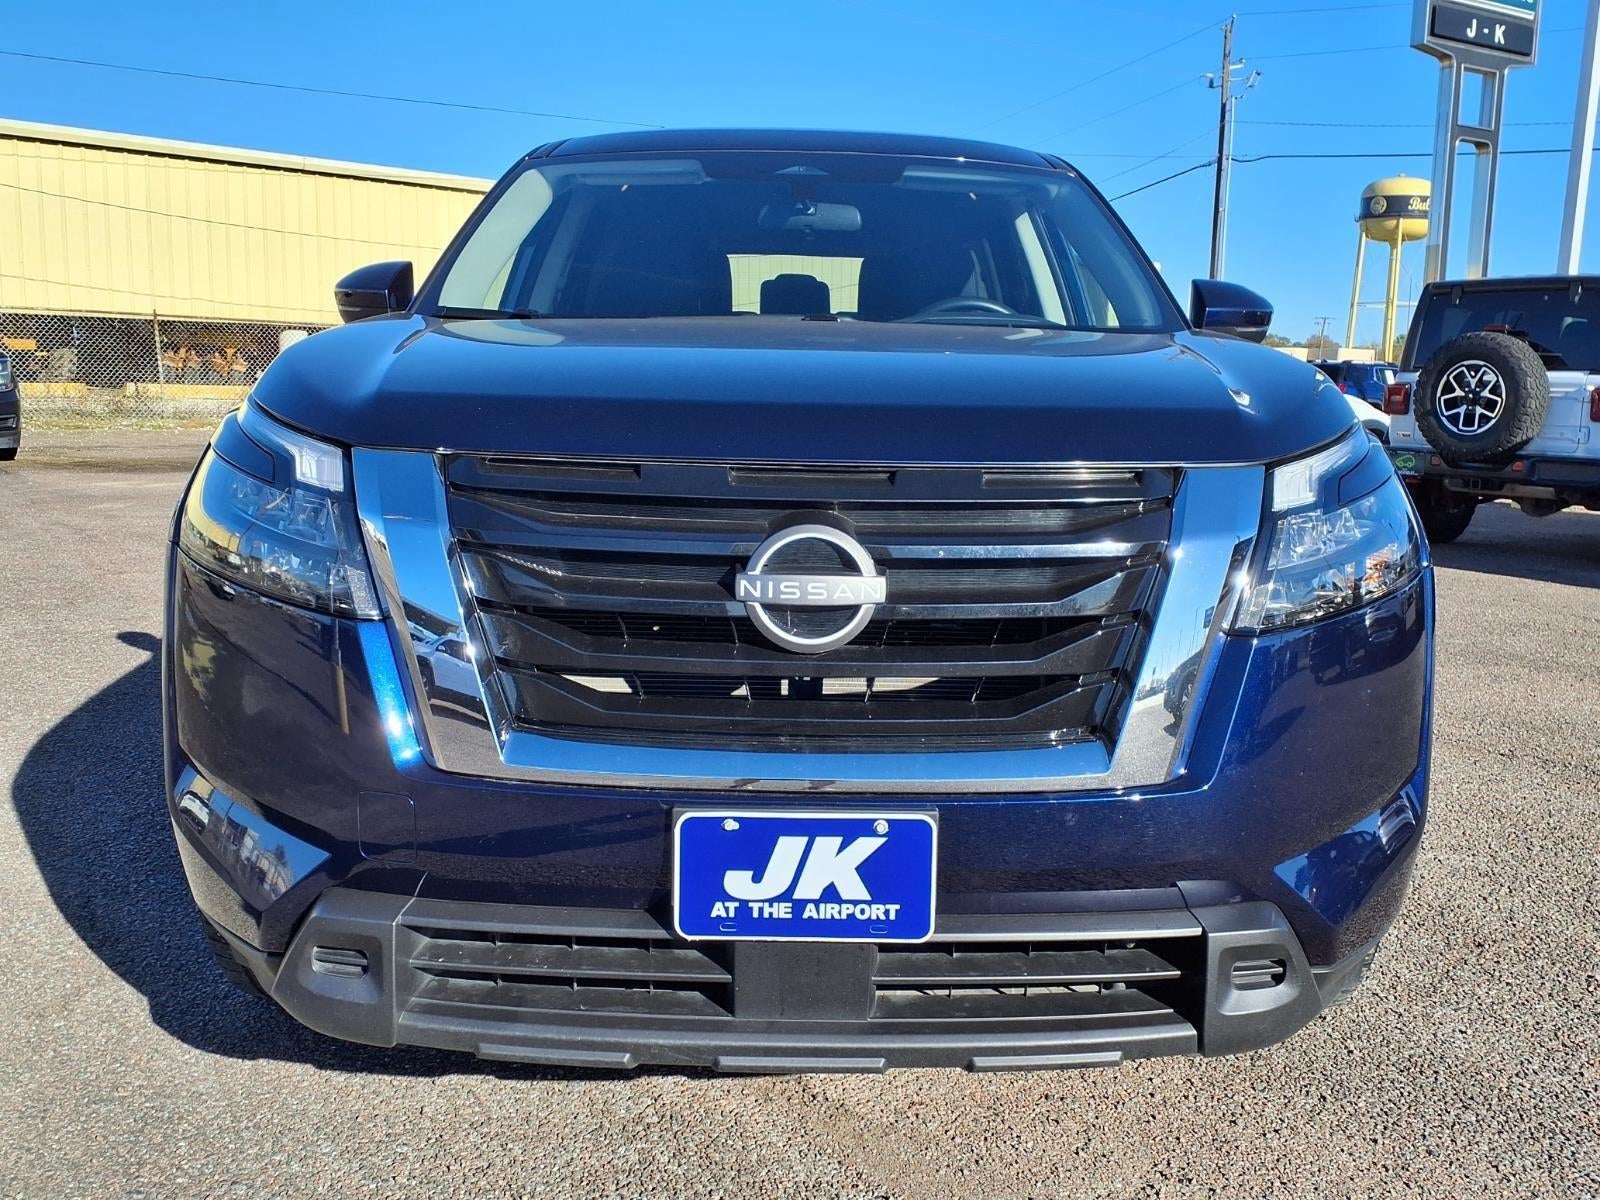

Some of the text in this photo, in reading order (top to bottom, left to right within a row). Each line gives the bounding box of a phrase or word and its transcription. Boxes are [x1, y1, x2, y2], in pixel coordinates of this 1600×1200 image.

[740, 579, 881, 600] NISSAN
[723, 836, 889, 900] JK
[711, 902, 901, 921] AT THE AIRPORT
